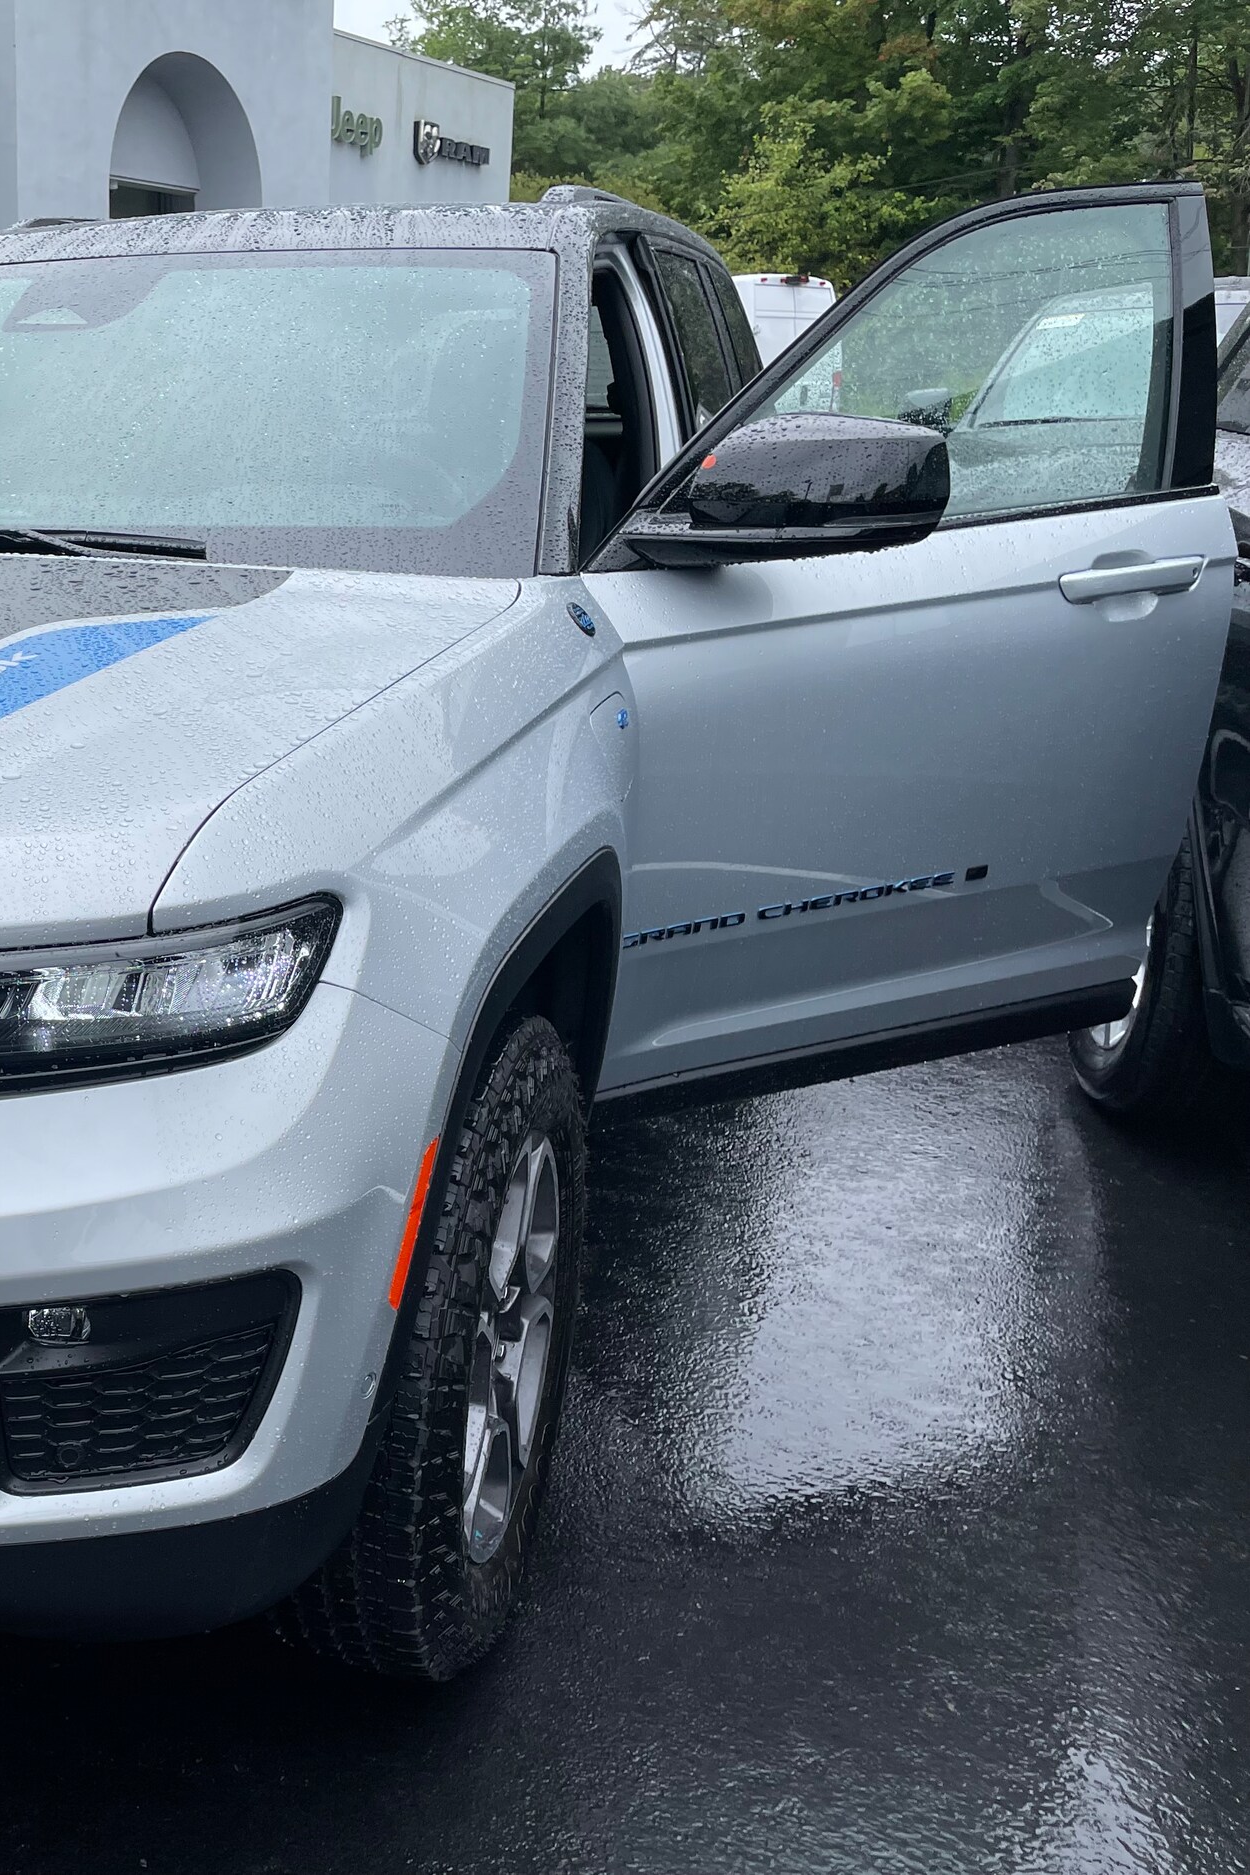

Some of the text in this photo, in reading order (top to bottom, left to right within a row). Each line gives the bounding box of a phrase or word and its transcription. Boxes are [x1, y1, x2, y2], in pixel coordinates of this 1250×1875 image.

[331, 95, 382, 156] Jeep
[438, 136, 490, 166] RAM
[757, 870, 956, 921] CHEROKEE
